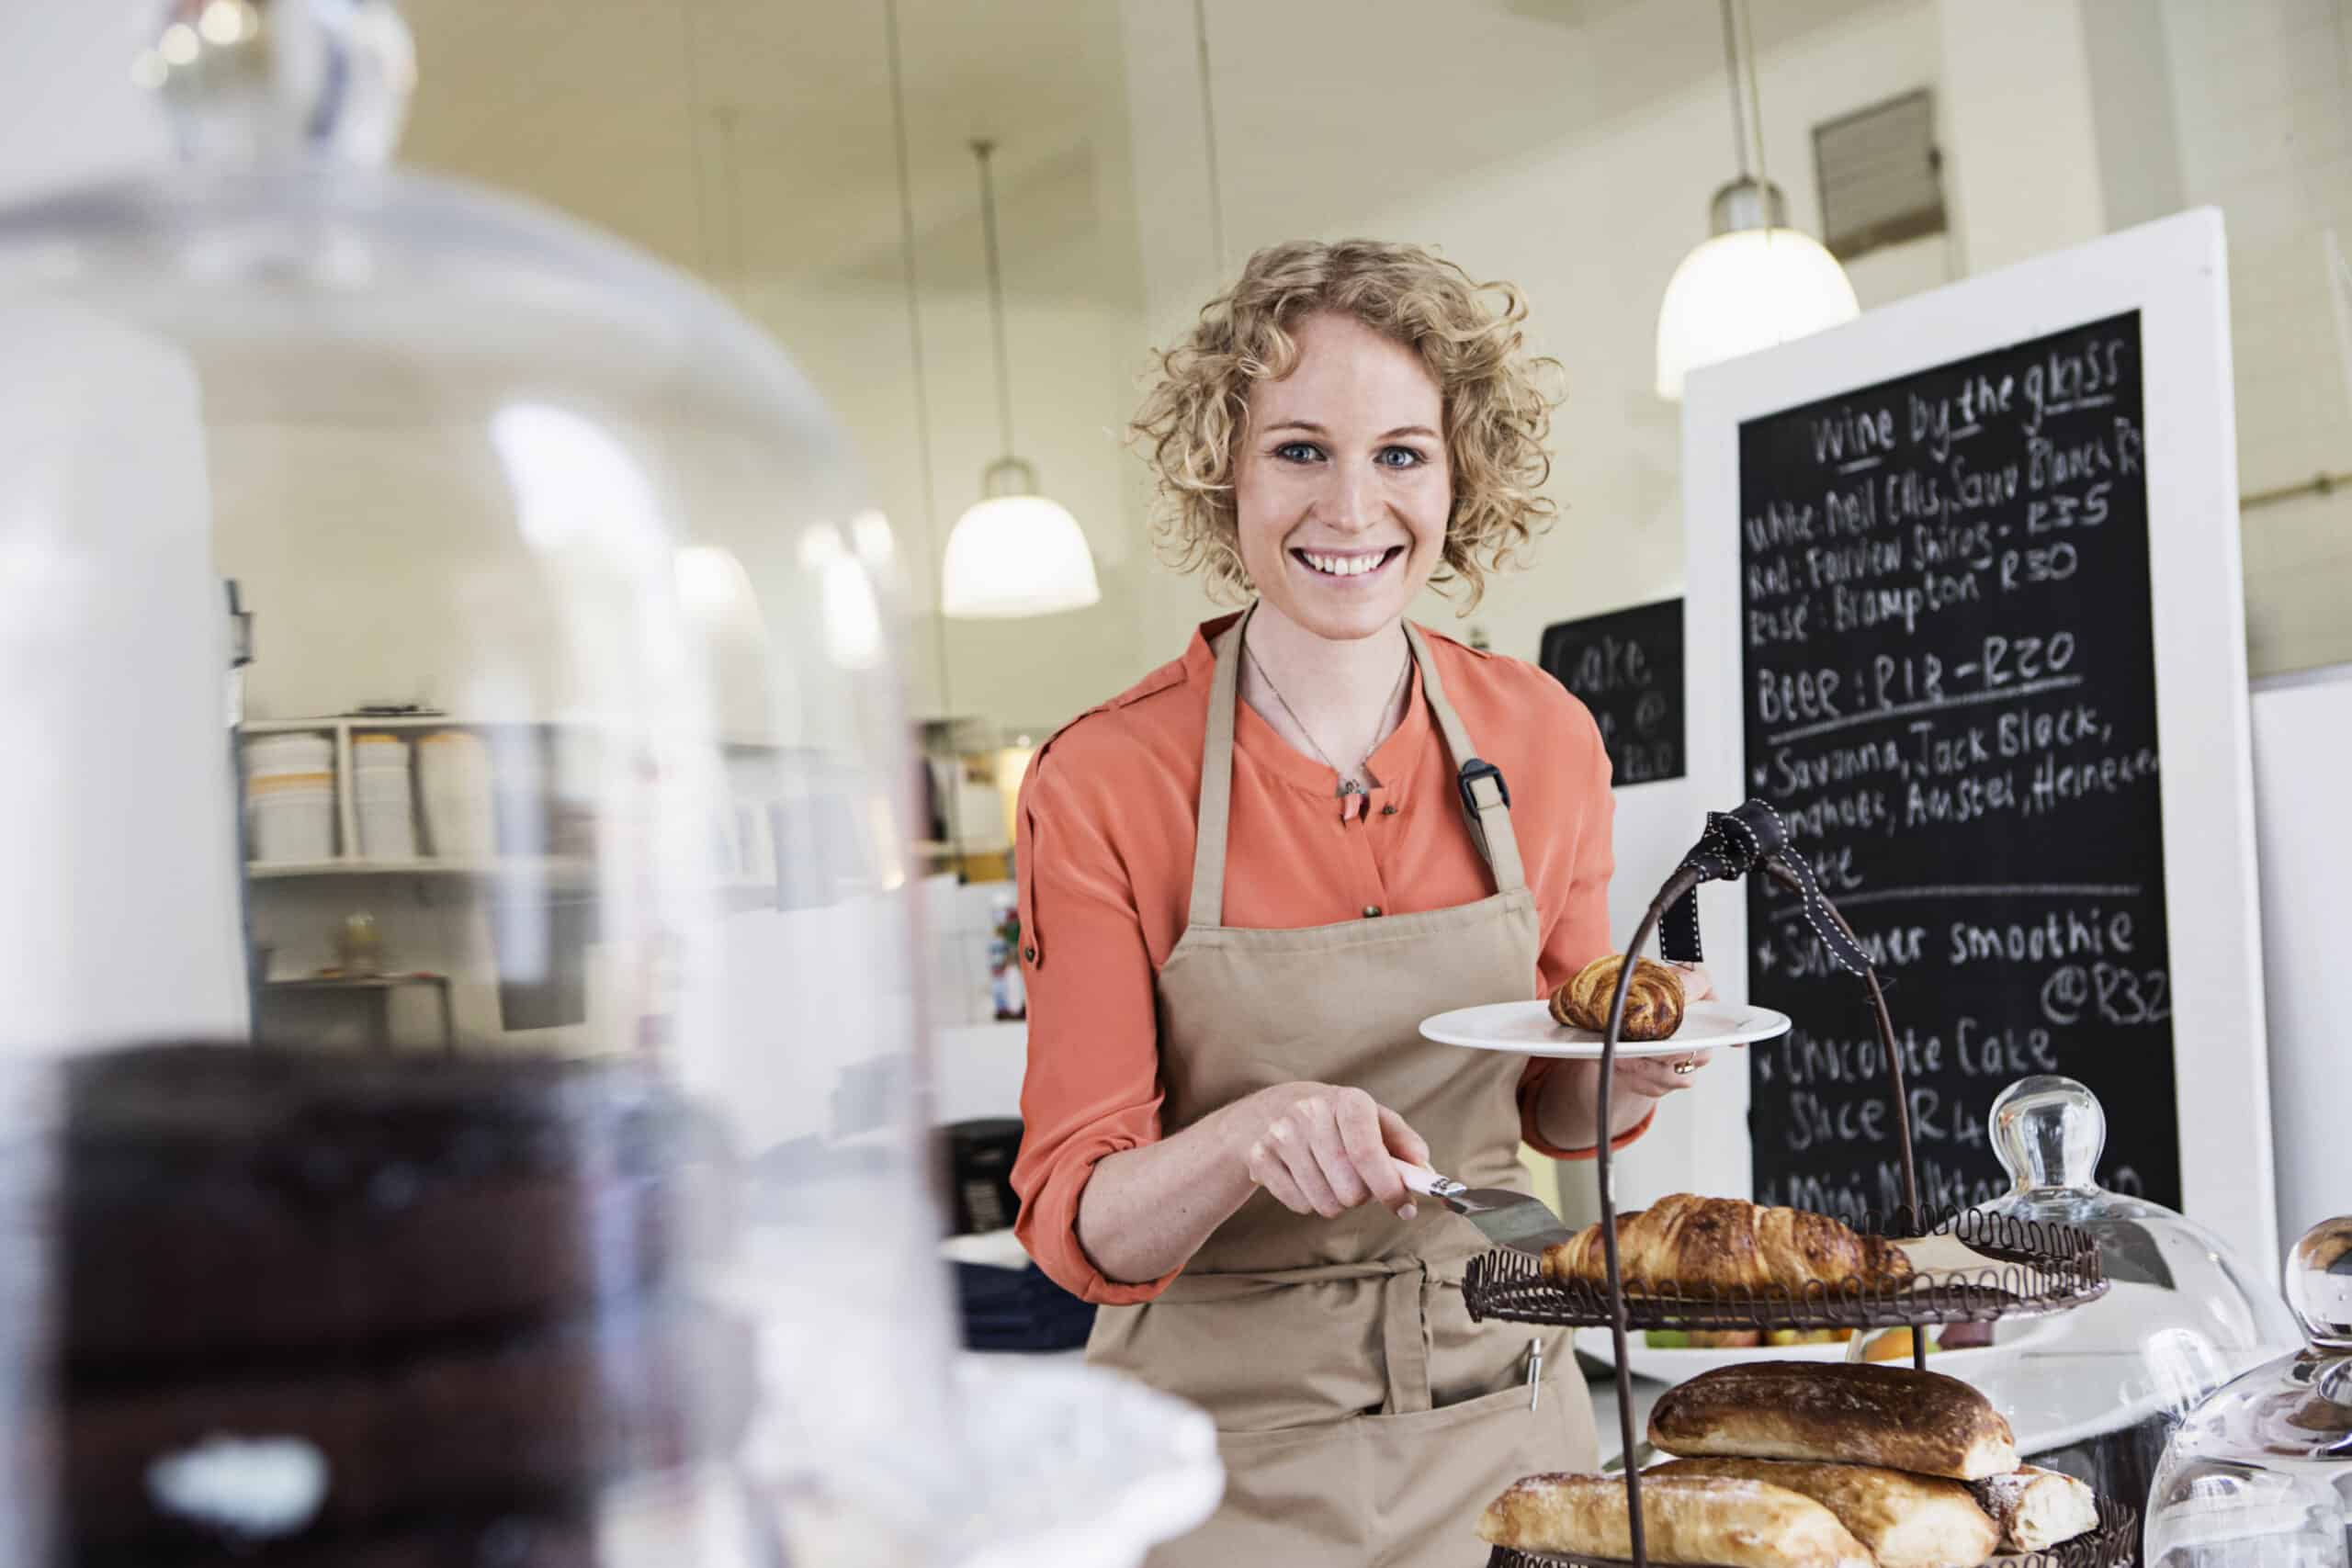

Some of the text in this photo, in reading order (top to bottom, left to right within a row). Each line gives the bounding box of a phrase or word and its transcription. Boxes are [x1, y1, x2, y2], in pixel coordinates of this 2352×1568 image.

[1808, 338, 2124, 464] Wine by the glass
[1909, 719, 1988, 779] Jack
[1949, 908, 2134, 966] smoothie
[1955, 1016, 2059, 1077] Cake
